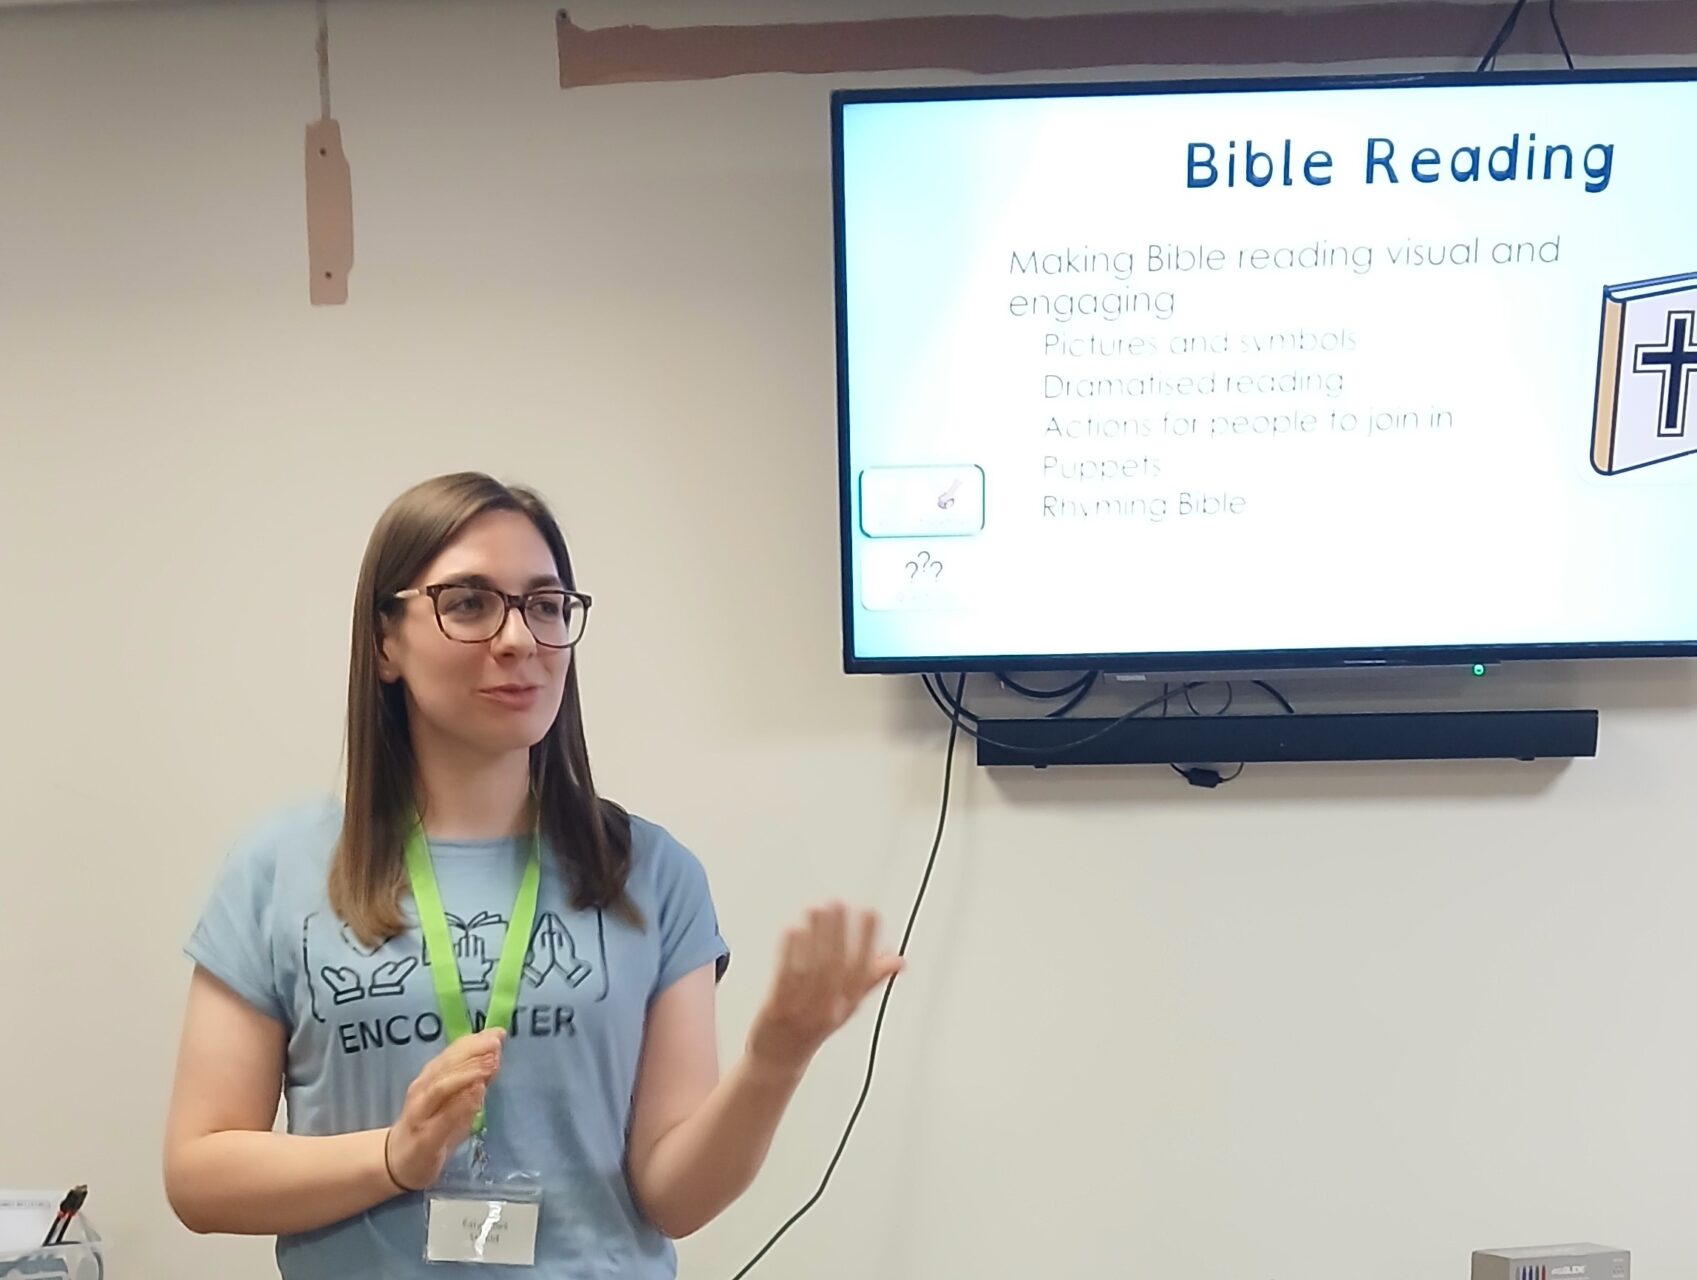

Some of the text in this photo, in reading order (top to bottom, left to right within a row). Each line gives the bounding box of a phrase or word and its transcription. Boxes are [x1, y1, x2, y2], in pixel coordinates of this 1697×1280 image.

[1186, 132, 1615, 194] Bible Reading
[1009, 234, 1561, 281] Making Bible reading visual and
[1009, 284, 1175, 323] engaging
[1044, 327, 1358, 358] Pictures and symbols
[1044, 368, 1344, 399] Dramatised reading
[1045, 403, 1454, 439] Actions for people to join in
[1043, 454, 1161, 483] Puppets
[1043, 490, 1247, 523] Rhyming Bible
[338, 1005, 576, 1054] ENCONTER
